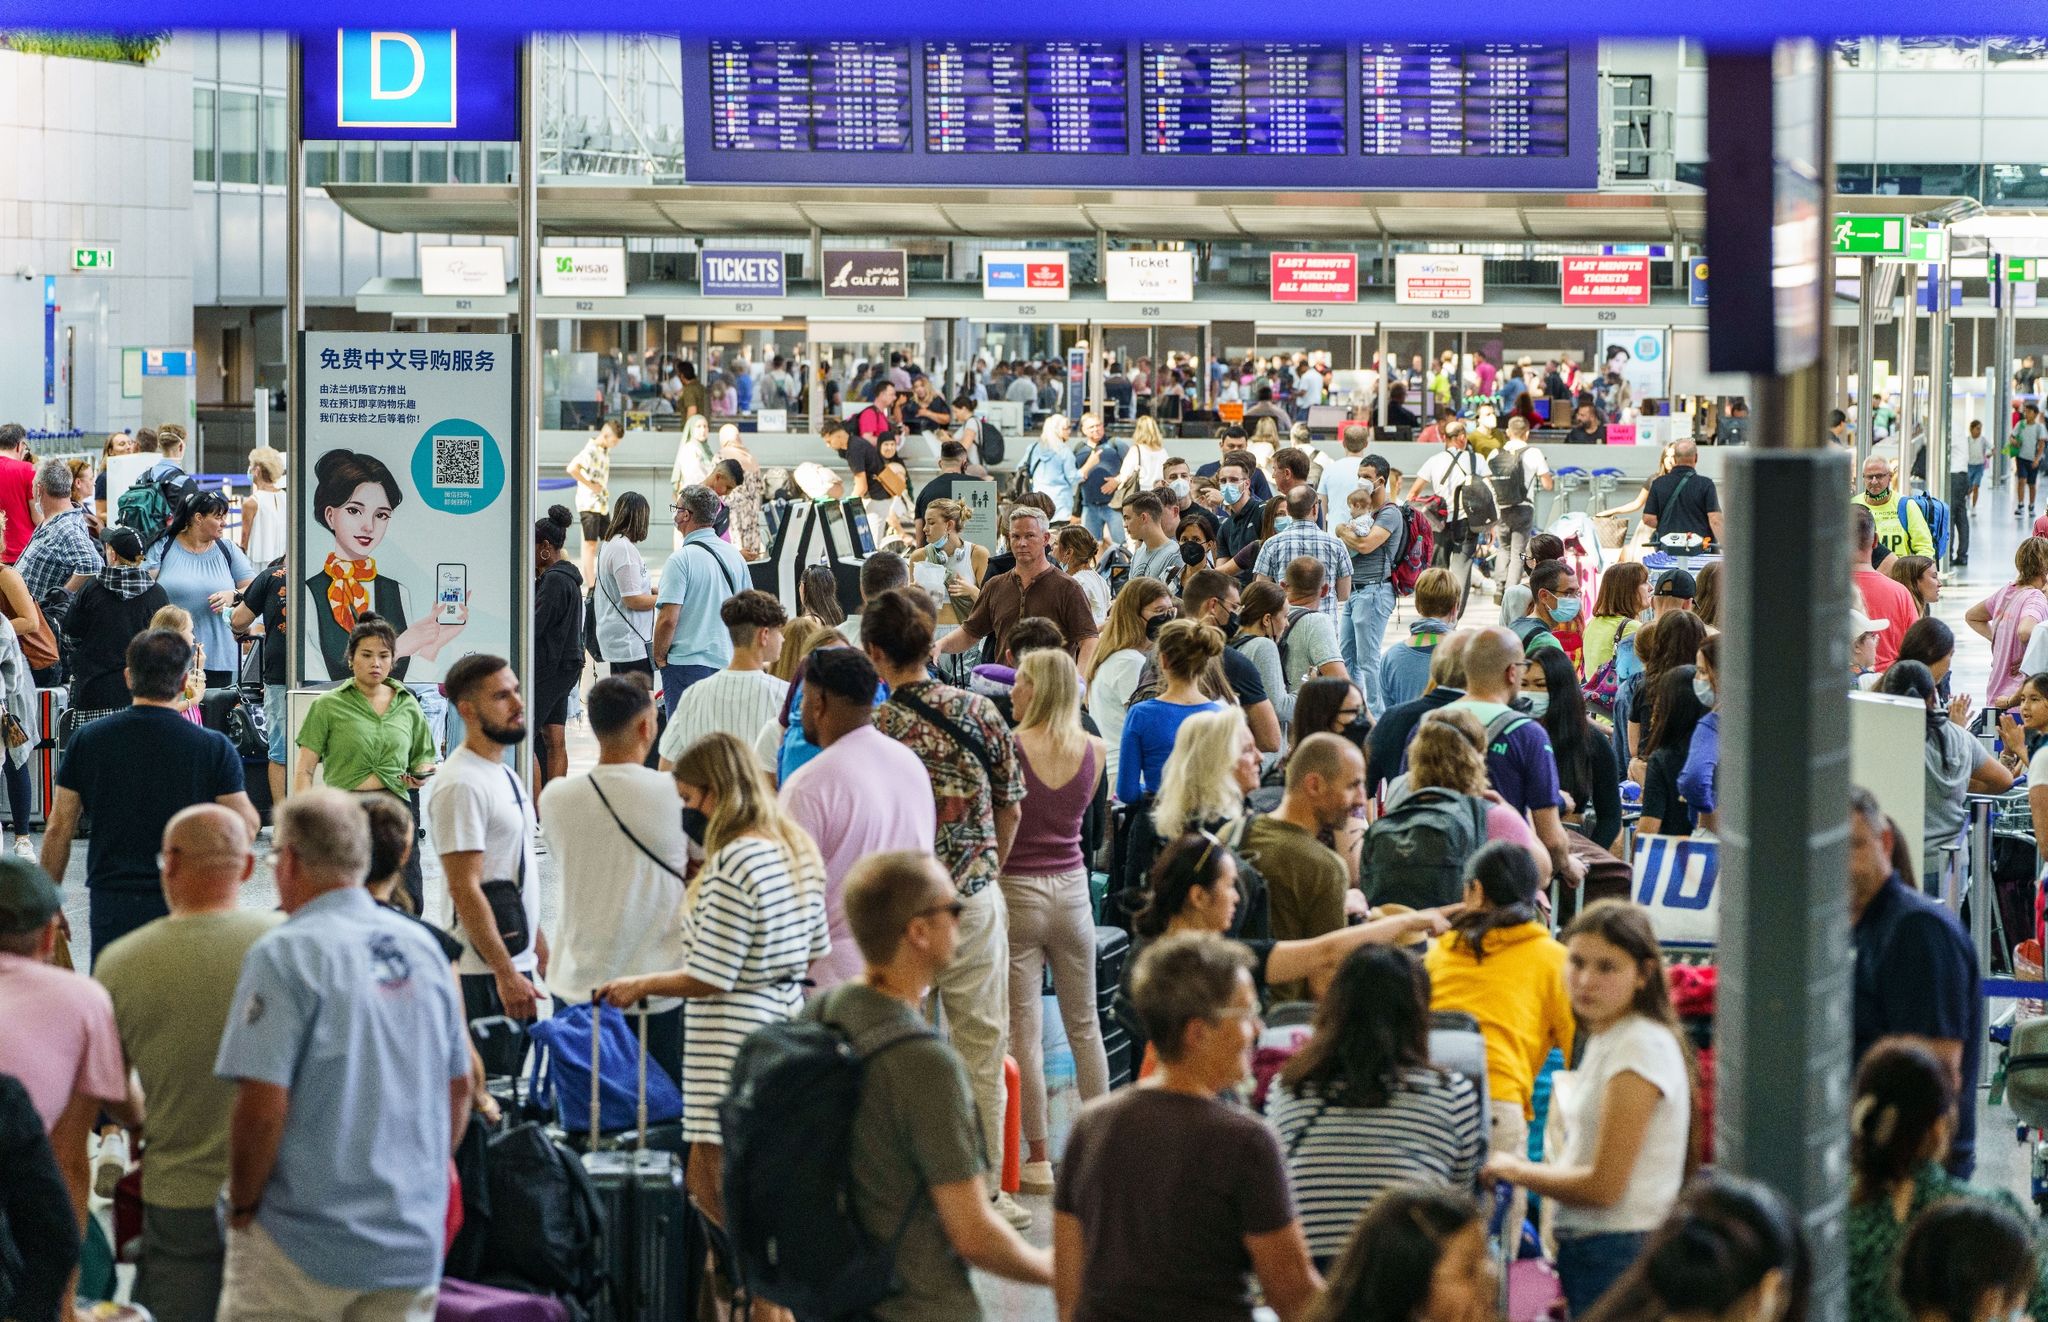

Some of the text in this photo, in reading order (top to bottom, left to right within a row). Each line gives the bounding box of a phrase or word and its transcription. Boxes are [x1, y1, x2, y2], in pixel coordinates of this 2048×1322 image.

[371, 32, 424, 100] D
[1129, 256, 1169, 268] Ticket
[1278, 258, 1350, 269] LAST MINUTE
[1569, 261, 1643, 270] LAST MINUTE
[706, 258, 779, 282] TICKETS
[1292, 271, 1336, 280] TICKETS
[1583, 274, 1629, 282] TICKETS
[851, 276, 899, 286] GULF AIR
[1278, 283, 1350, 293] ALL AIRLINES
[1569, 286, 1642, 295] ALL AIRLINES
[736, 304, 753, 312] 823
[857, 304, 875, 312] 824
[1019, 306, 1036, 314] 825
[1142, 307, 1160, 315] 826
[1306, 309, 1323, 317] 827
[1432, 310, 1450, 318] 828
[1598, 312, 1616, 320] 829
[320, 348, 495, 372] 免费中文导购服务
[320, 384, 406, 395] 由法兰机场官方推出
[320, 399, 416, 409] 现在预订即享购物乐趣
